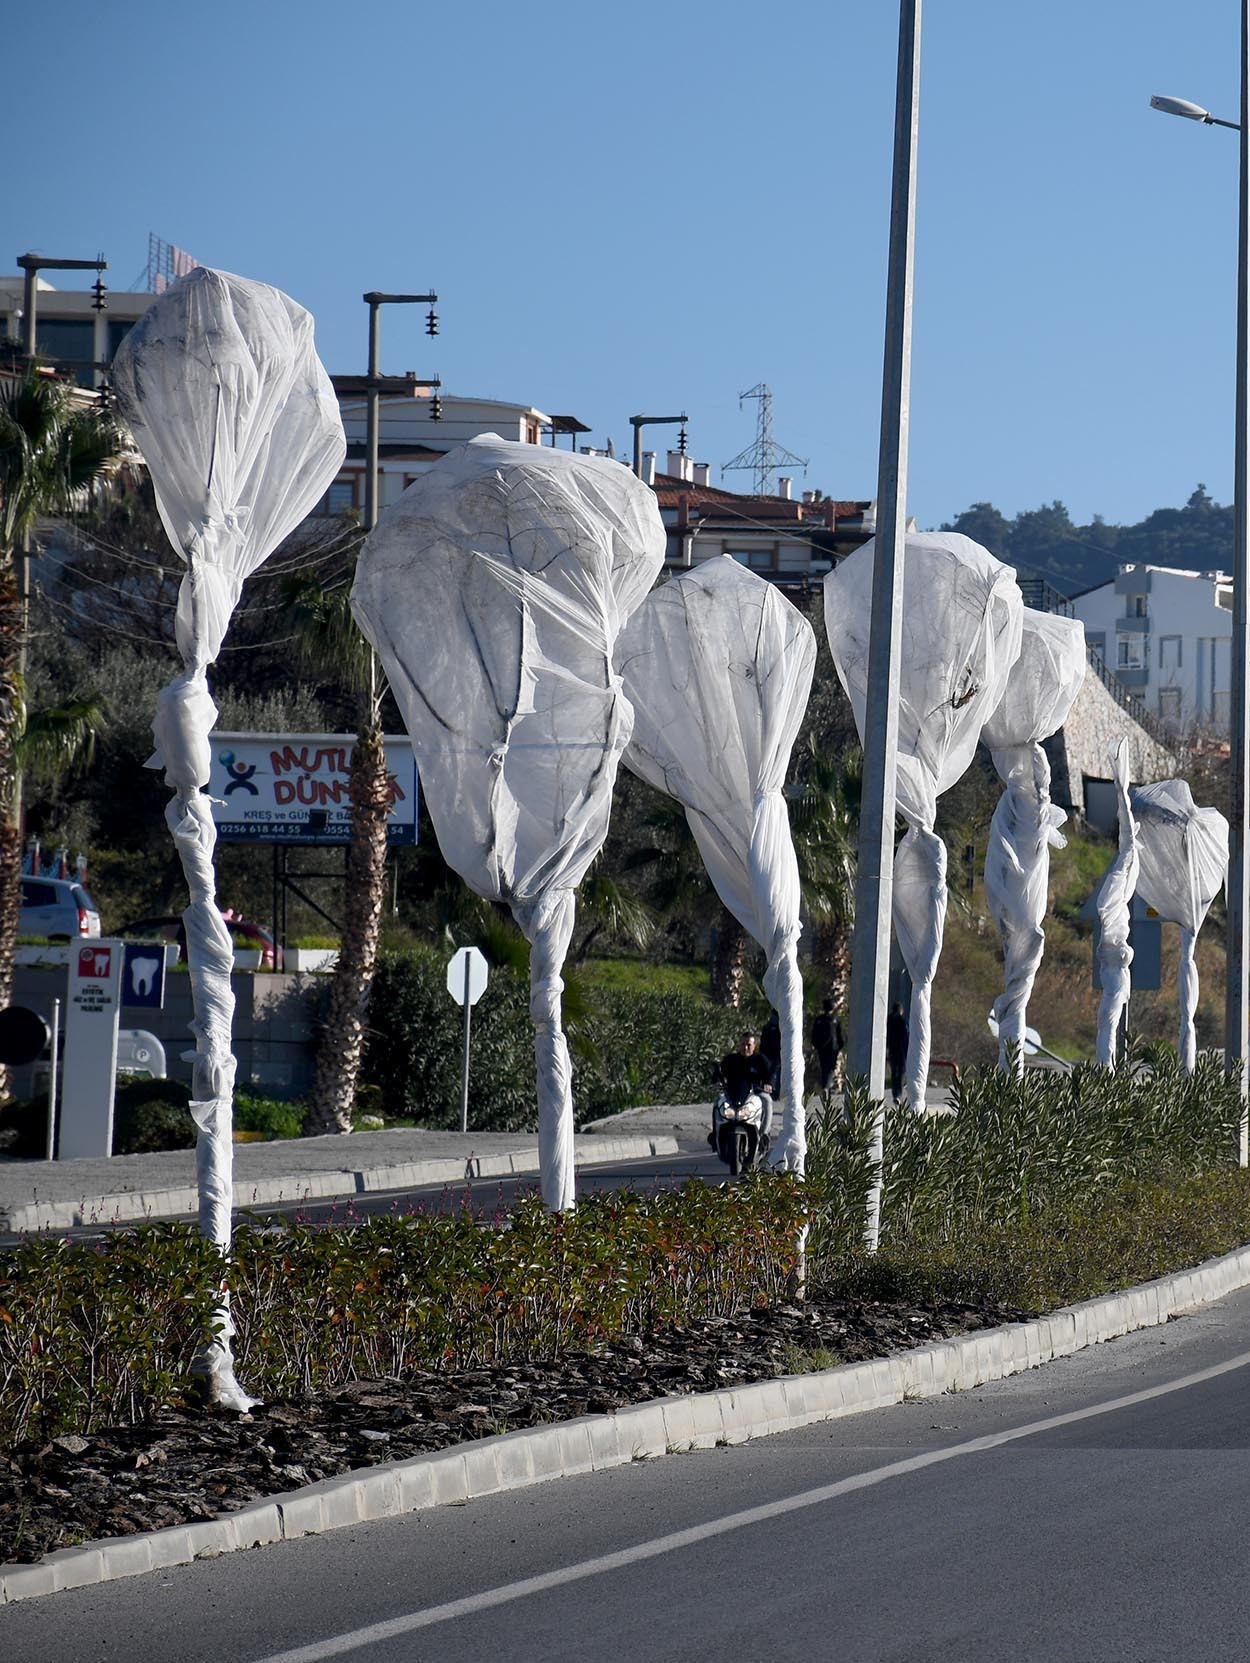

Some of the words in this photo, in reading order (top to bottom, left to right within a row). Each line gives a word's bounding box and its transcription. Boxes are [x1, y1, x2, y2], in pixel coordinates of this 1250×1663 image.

[270, 745, 356, 776] MUTL
[243, 810, 272, 821] KREŞ
[274, 812, 286, 820] ve
[220, 824, 247, 834] 0256
[249, 824, 269, 834] 618
[271, 824, 285, 834] 44
[287, 825, 301, 834] 55
